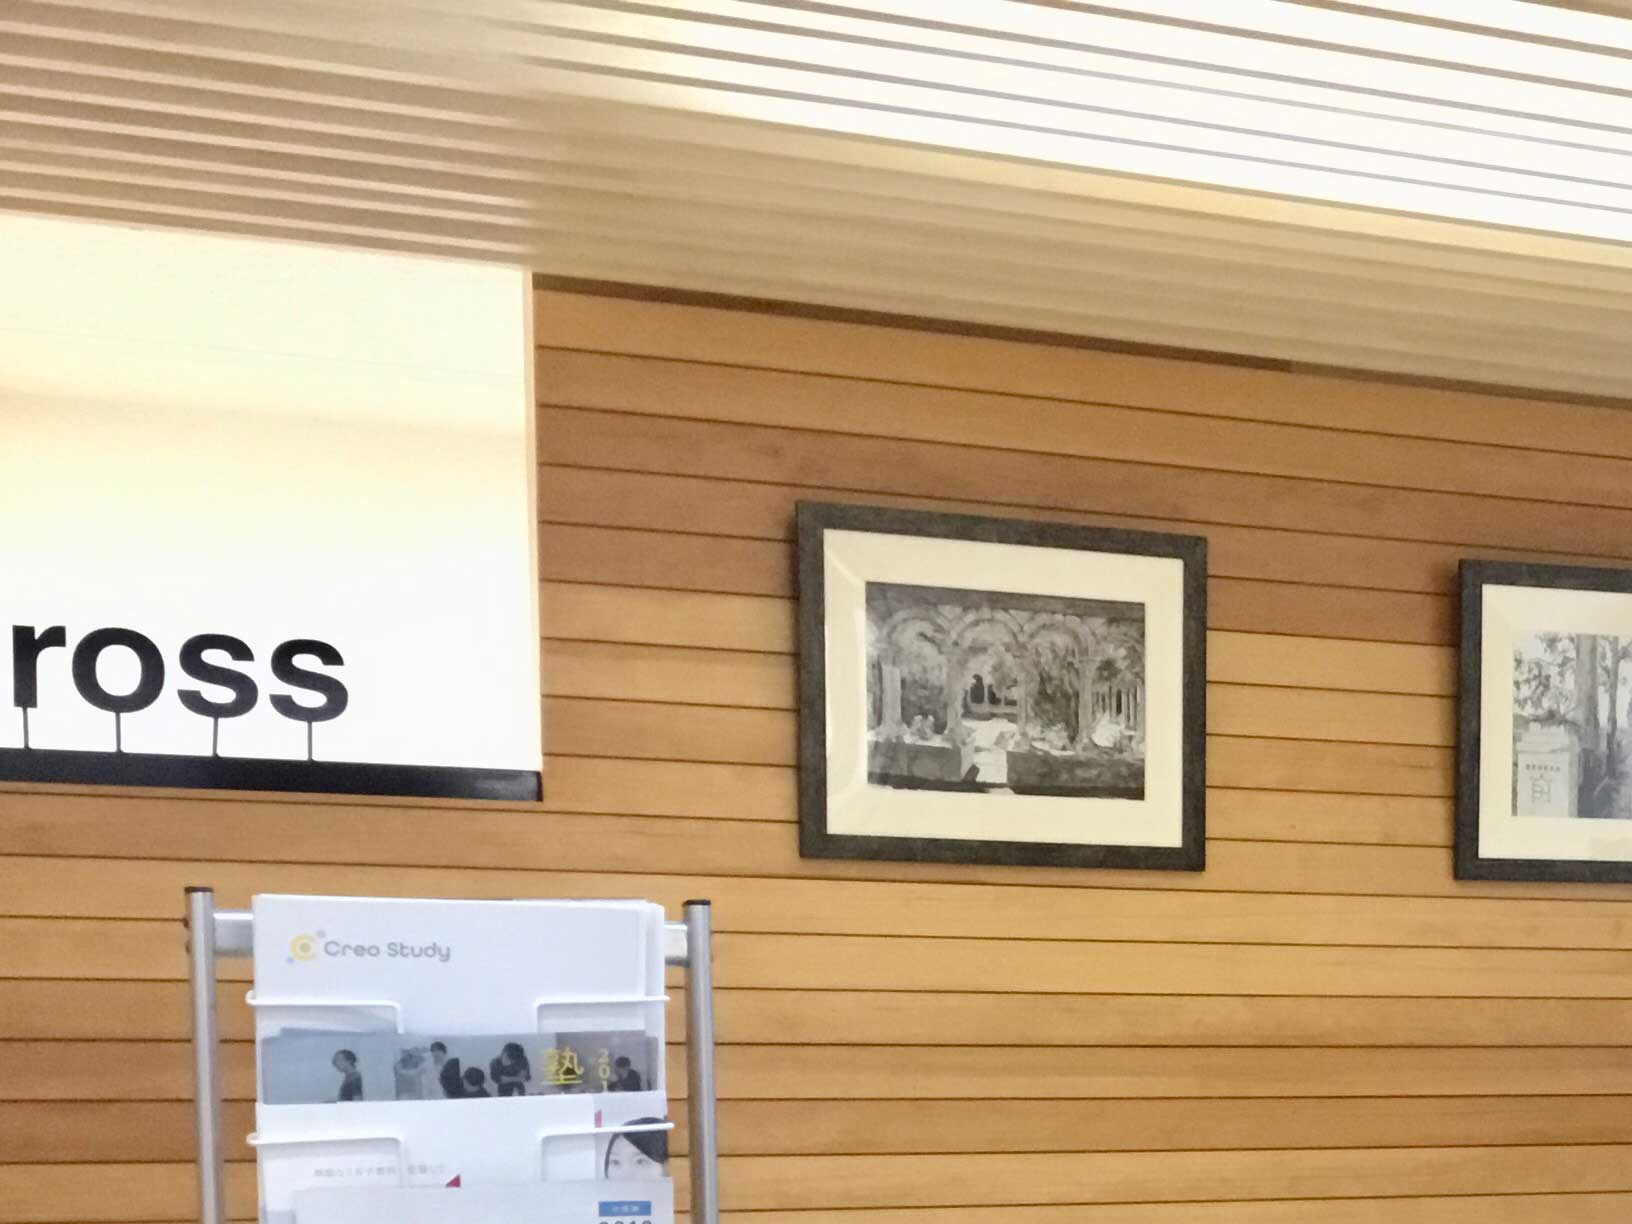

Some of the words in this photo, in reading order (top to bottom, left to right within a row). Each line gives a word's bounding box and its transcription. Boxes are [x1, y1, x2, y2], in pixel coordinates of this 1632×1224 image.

[12, 624, 349, 723] ross
[323, 940, 380, 959] Creo
[387, 941, 451, 963] Study
[542, 1047, 584, 1085] 塾
